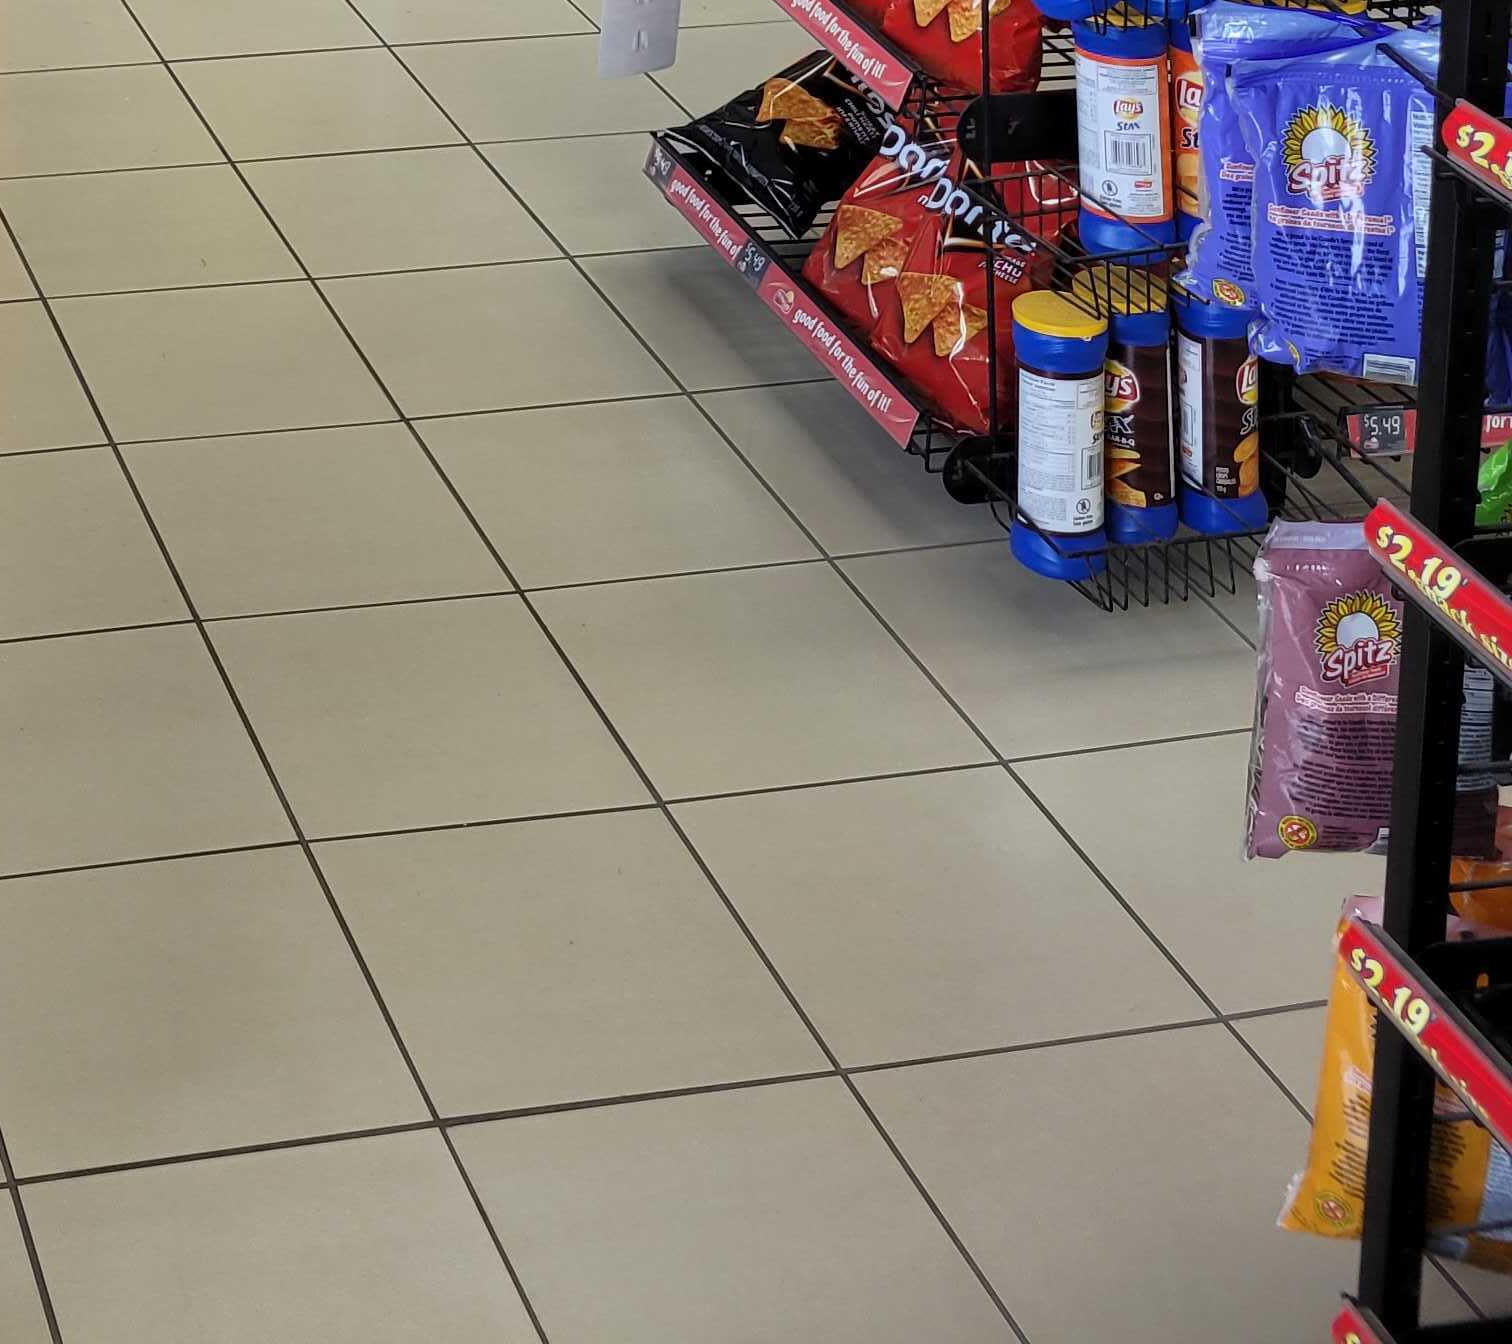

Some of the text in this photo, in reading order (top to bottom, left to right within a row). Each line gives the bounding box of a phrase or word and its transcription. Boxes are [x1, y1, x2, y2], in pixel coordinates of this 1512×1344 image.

[810, 2, 831, 25] food
[828, 15, 841, 35] for
[839, 29, 853, 51] the
[848, 41, 865, 64] fun
[791, 308, 881, 406] good food for the fun of
[1364, 414, 1401, 436] $5.49
[1376, 525, 1462, 601] $2.19
[1326, 638, 1393, 681] Spitz
